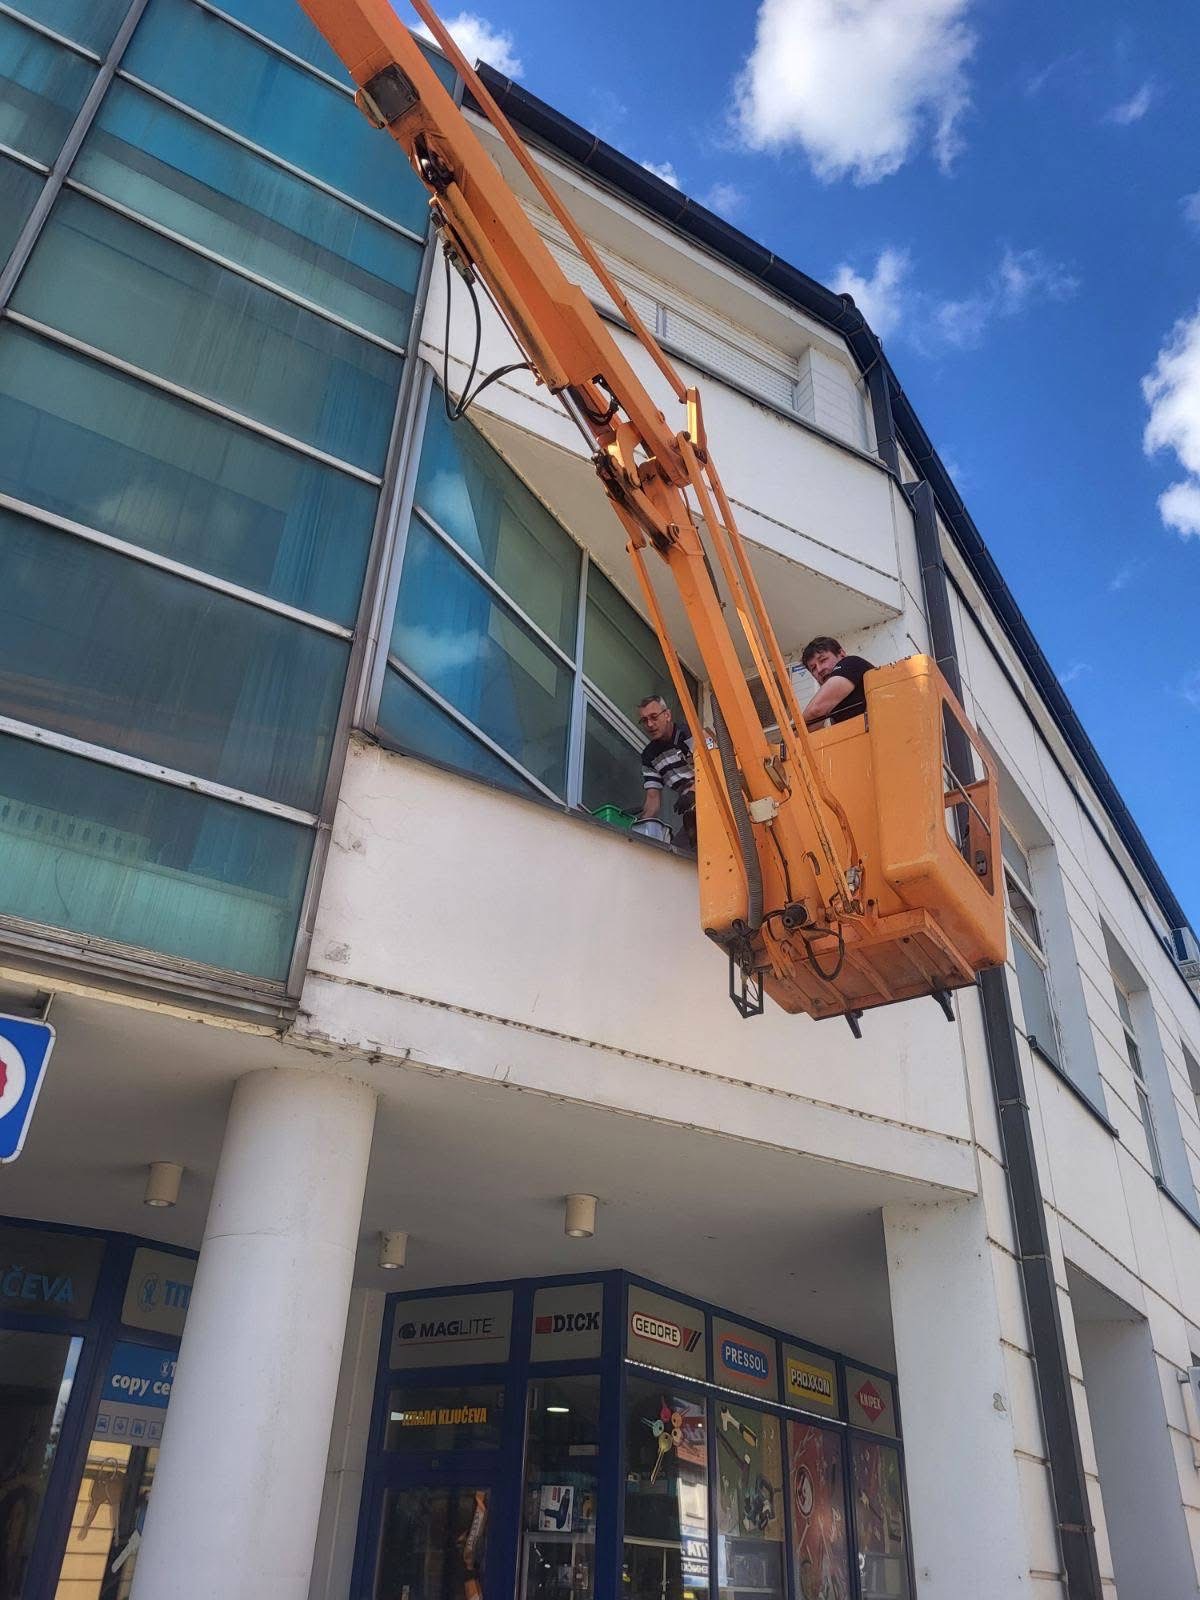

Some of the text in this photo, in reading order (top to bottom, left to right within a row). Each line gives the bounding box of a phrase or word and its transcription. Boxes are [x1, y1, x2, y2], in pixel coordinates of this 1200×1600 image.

[419, 1318, 492, 1338] MAGLITE
[553, 1311, 600, 1333] DICK
[635, 1317, 678, 1343] GEDORE
[725, 1345, 767, 1374] PRESSOL
[112, 1374, 171, 1396] copy ce
[790, 1367, 831, 1396] PROXXON
